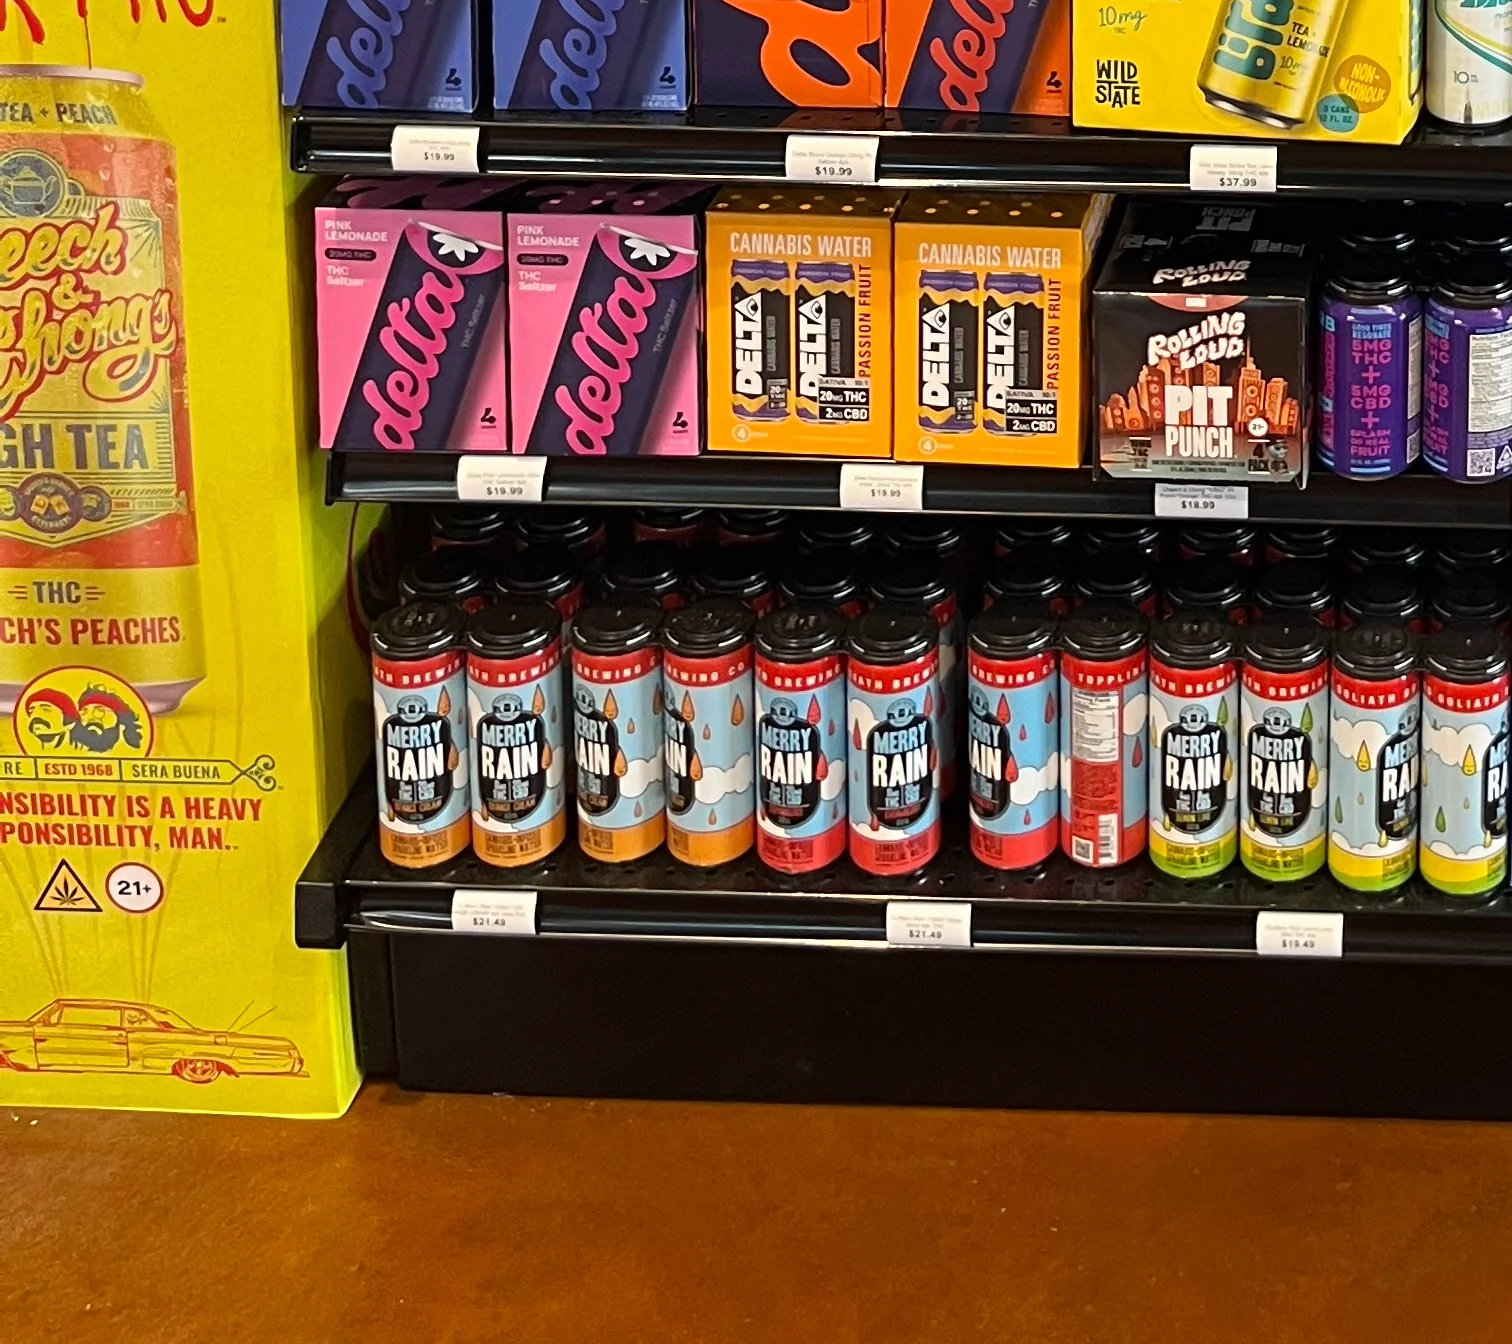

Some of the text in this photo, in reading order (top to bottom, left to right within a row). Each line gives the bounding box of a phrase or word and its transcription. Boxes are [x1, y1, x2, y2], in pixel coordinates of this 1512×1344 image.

[1219, 178, 1257, 188] $37.99
[1148, 312, 1245, 366] ROLLING
[1179, 337, 1244, 370] LOUD
[1165, 384, 1233, 425] PIT
[1166, 426, 1233, 458] PUNCH
[486, 486, 523, 496] $19.99
[33, 581, 81, 605] THC
[69, 616, 180, 646] PEACHES
[480, 720, 536, 749] MERRY
[44, 763, 221, 780] ESTD 1968 SERA BUENA
[481, 747, 540, 780] RAIN
[127, 794, 262, 822] IS A HEAVY
[117, 881, 152, 897] 21+
